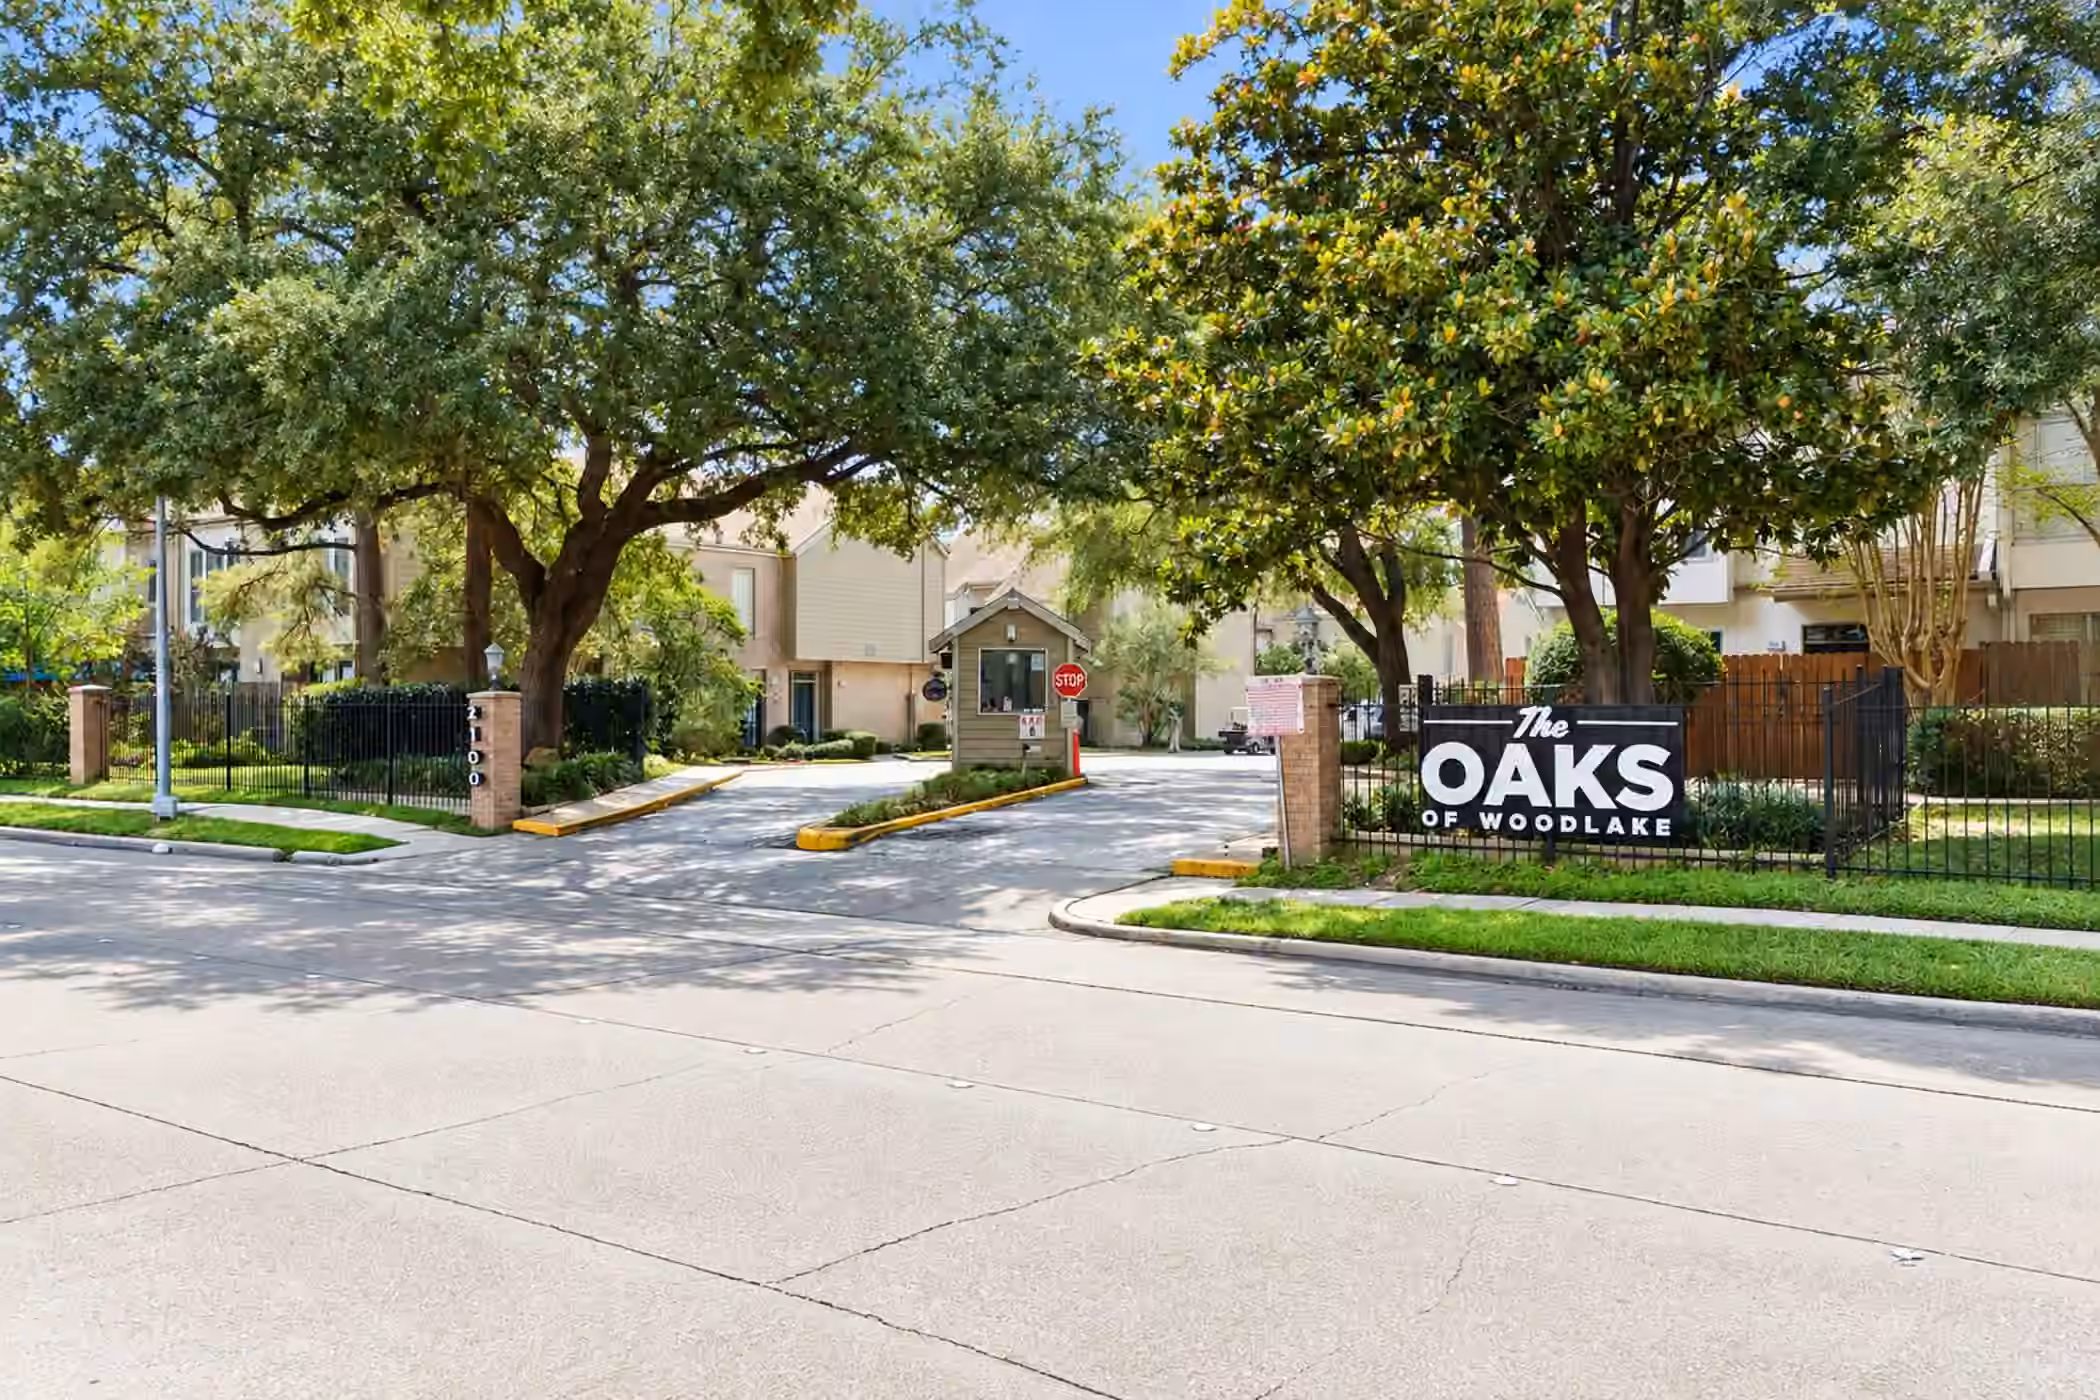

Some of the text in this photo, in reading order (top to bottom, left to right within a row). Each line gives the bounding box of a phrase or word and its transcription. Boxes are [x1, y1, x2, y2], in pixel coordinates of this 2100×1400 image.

[1055, 673, 1084, 687] STOP
[1513, 705, 1569, 738] The
[467, 705, 480, 785] 2100
[1421, 741, 1674, 811] OAKS
[1421, 810, 1672, 836] OF WOODLAKE
